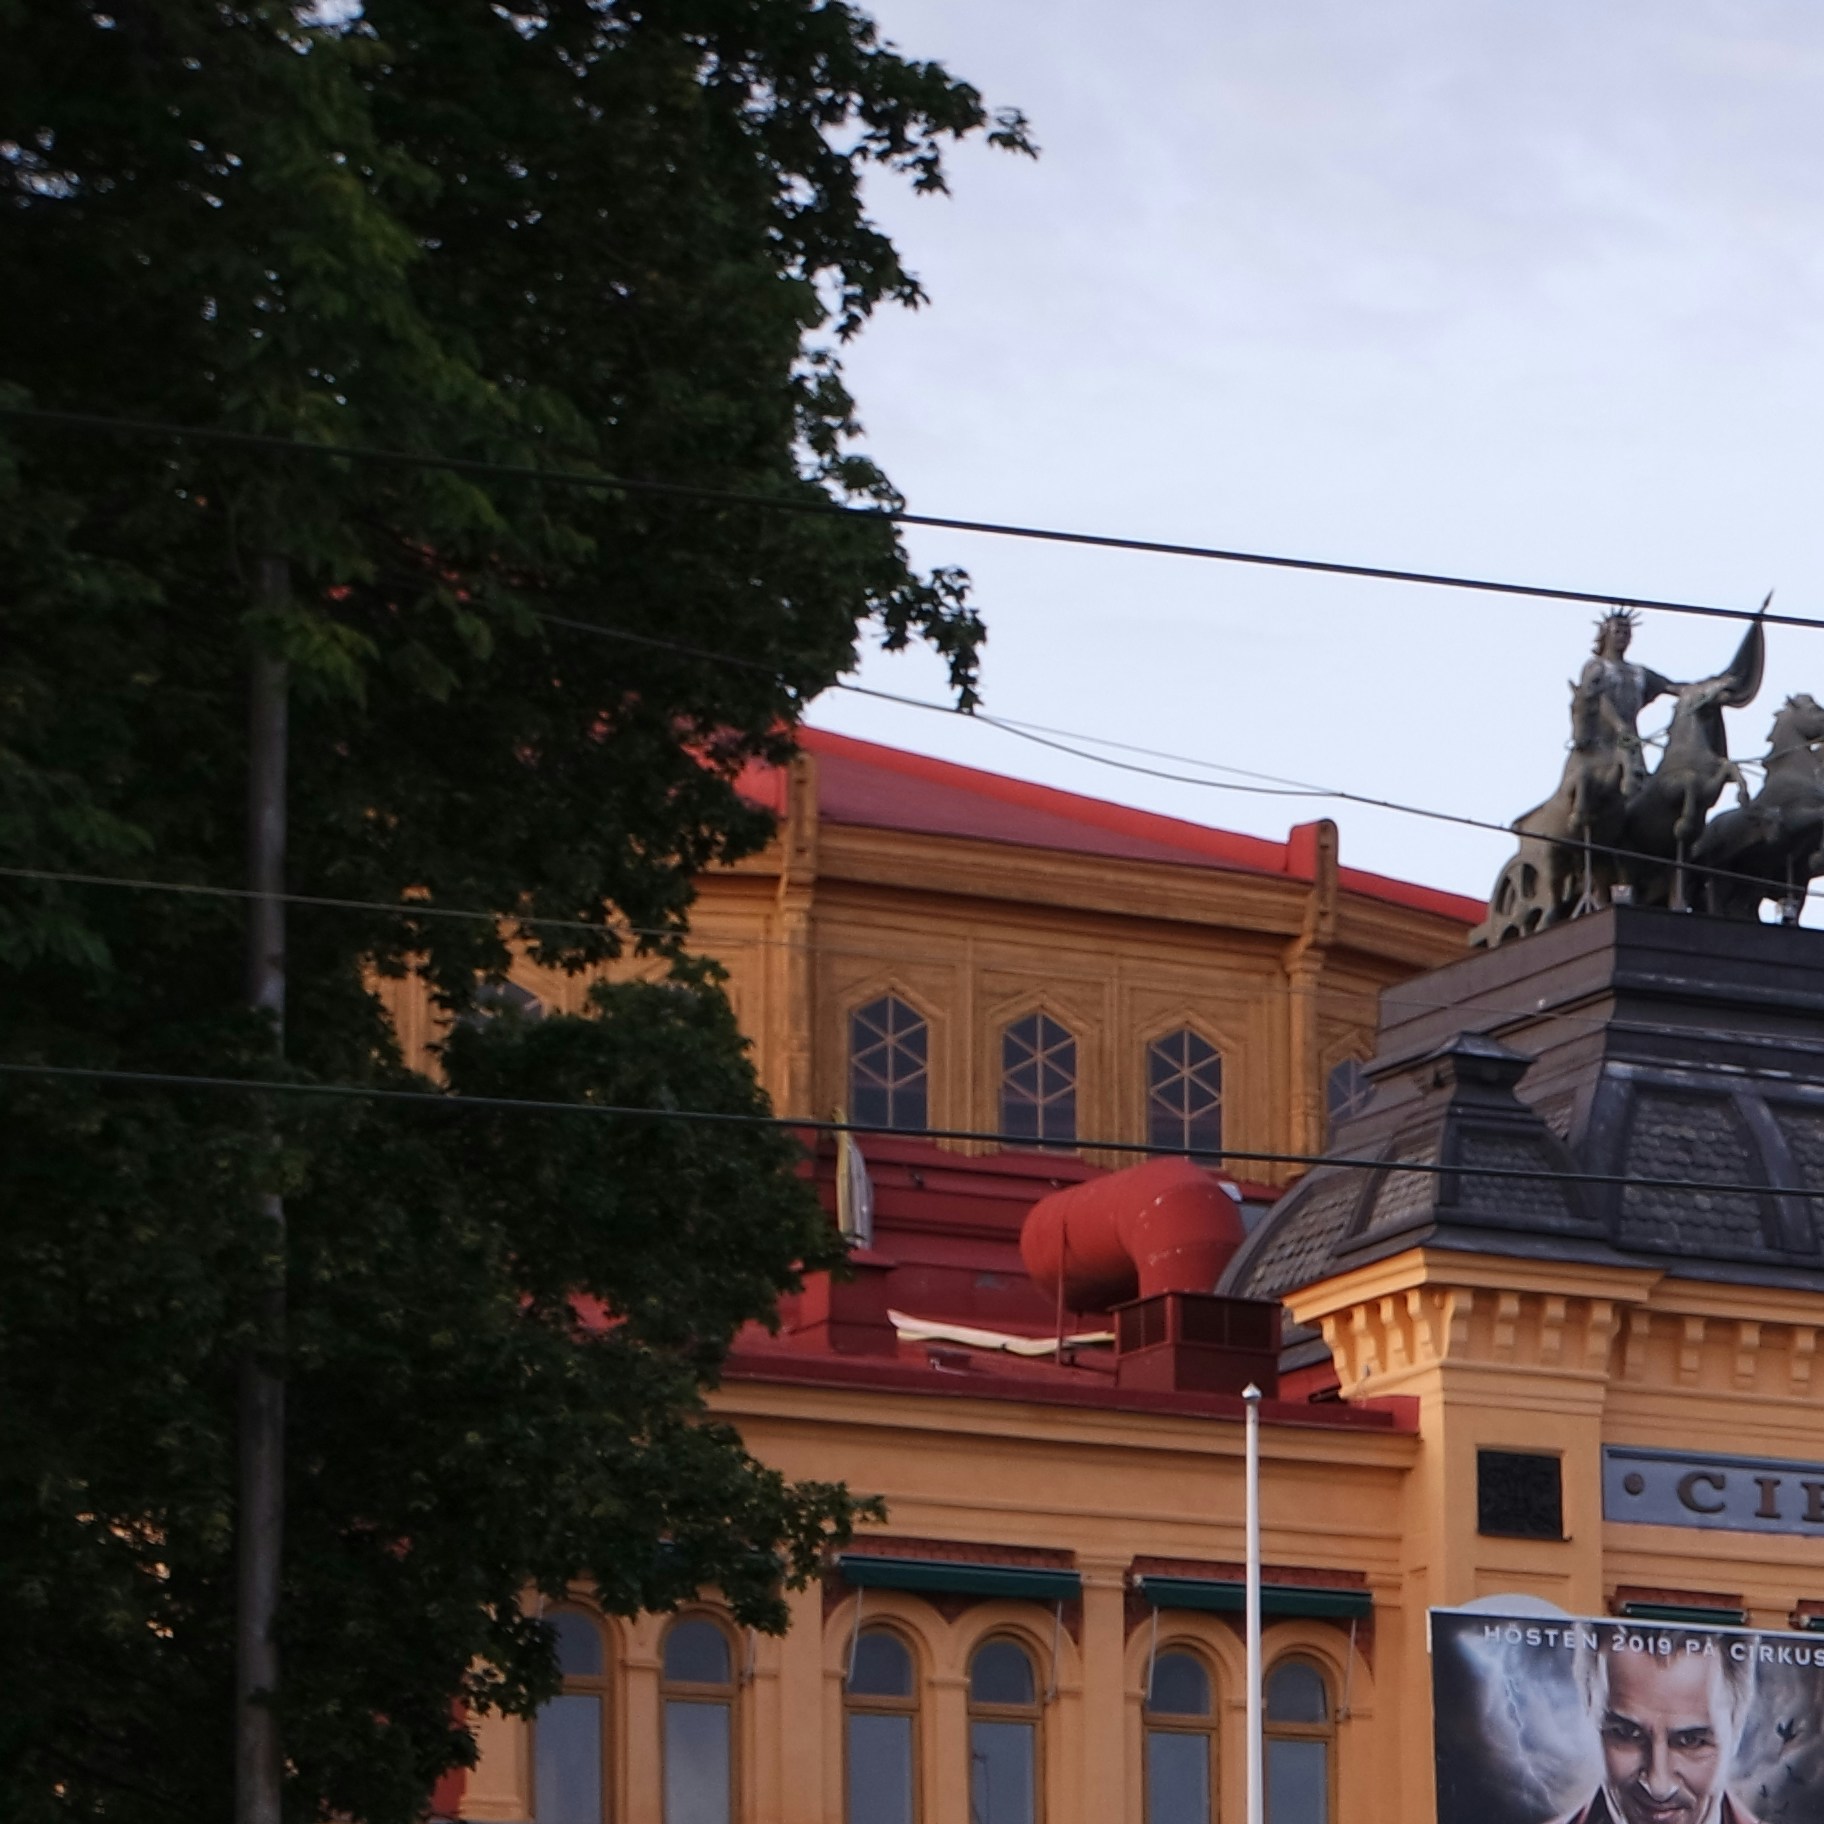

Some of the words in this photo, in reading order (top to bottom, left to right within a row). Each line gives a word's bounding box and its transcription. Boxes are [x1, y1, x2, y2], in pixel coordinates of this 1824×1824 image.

[1483, 1624, 1598, 1651] HÖSTEN
[1612, 1634, 1672, 1656] 2019
[1686, 1638, 1718, 1658] PÅ
